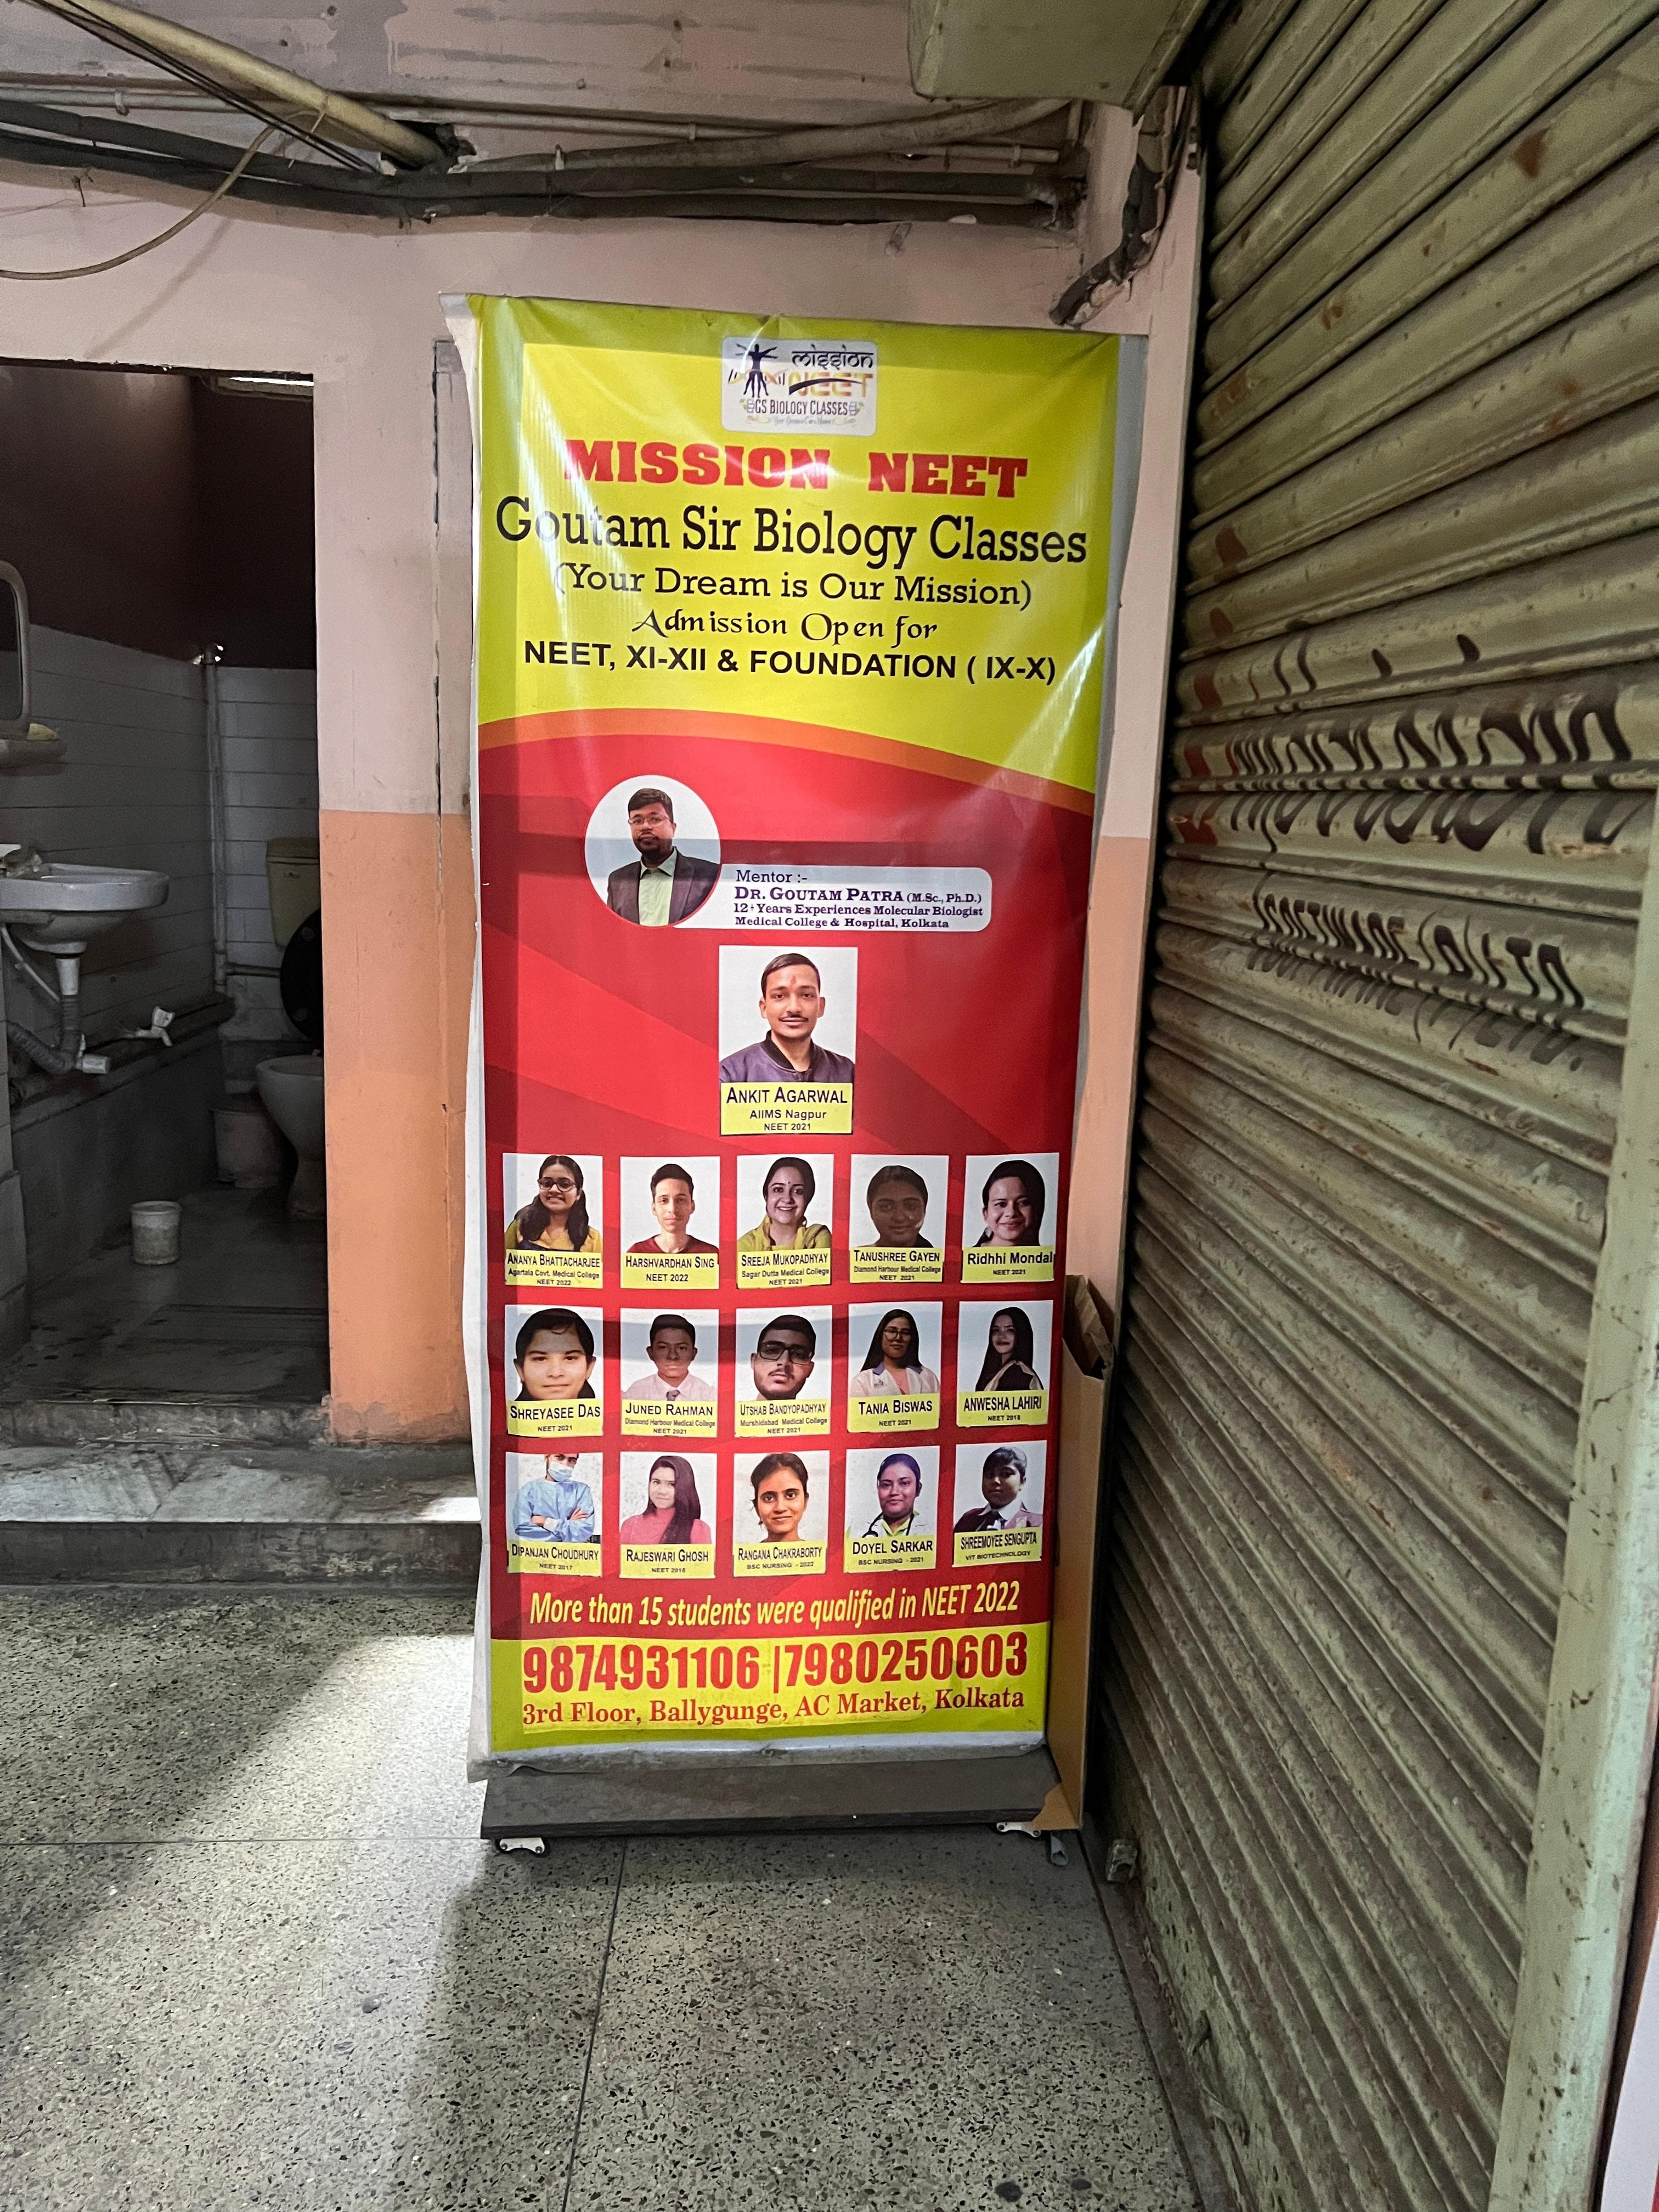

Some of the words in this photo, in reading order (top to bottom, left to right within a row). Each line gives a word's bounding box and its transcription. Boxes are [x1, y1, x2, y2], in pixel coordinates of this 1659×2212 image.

[792, 344, 873, 370] mission
[755, 399, 767, 414] GS
[770, 400, 808, 415] BIOLOGY
[810, 401, 848, 416] CLASSES
[565, 439, 830, 489] MISSION
[868, 453, 1028, 498] NEET
[496, 497, 670, 548] Goutam
[683, 505, 741, 550] Sir
[754, 507, 917, 569] Biology
[929, 514, 1087, 563] Classes
[556, 562, 645, 595] (Your
[654, 567, 771, 596] Dream
[780, 572, 806, 598] is
[819, 573, 881, 601] Our
[893, 576, 1032, 611] Mission)
[632, 608, 787, 638] Admission
[801, 612, 884, 646] Open
[891, 613, 938, 649] for
[524, 640, 615, 669] NEET,
[626, 645, 706, 671] XI-XII
[717, 649, 739, 673] &
[750, 650, 957, 679] FOUNDATION
[986, 657, 1056, 684] IX-X)
[736, 870, 792, 883] Mentor
[798, 873, 808, 883] :-
[734, 887, 766, 900] DR.
[770, 887, 842, 901] GOUTAM
[847, 888, 904, 902] PATRA
[946, 893, 982, 904] Ph.D.)
[794, 905, 871, 917] Experiences
[874, 906, 930, 916] Molecular
[932, 906, 983, 918] Biologist
[735, 917, 782, 926] Medical
[785, 917, 827, 928] College
[830, 919, 839, 927] &
[845, 918, 899, 929] Hospital,
[901, 918, 949, 928] Kolkata
[726, 1087, 770, 1103] ANKIT
[774, 1086, 848, 1103] AGARWAL
[786, 1110, 827, 1121] Nagpur
[507, 1252, 537, 1265] ANANYA
[540, 1254, 600, 1268] BHATTACHARJEE
[625, 1256, 692, 1268] HARSHVARDHAN
[695, 1256, 715, 1268] SING
[741, 1254, 770, 1267] SREEJA
[772, 1252, 828, 1266] MUKOPADHYAY
[854, 1250, 905, 1262] TANUSHREE
[909, 1250, 940, 1262] GAYEN
[968, 1252, 1006, 1265] Ridhhi
[1010, 1251, 1053, 1264] Mondal
[577, 1271, 600, 1279] College
[646, 1273, 668, 1282] NEET
[670, 1273, 689, 1282] 2022
[742, 1271, 760, 1279] Sagar
[510, 1405, 574, 1420] SHREYASEE
[578, 1403, 601, 1418] DAS
[625, 1402, 662, 1415] JUNED
[666, 1403, 713, 1416] RAHMAN
[741, 1403, 767, 1416] UTSHAB
[769, 1402, 826, 1415] BANDYOPADHYAY
[859, 1401, 889, 1415] TANIA
[893, 1400, 933, 1414] BISWAS
[963, 1396, 1010, 1412] ANWESHA
[1012, 1396, 1042, 1410] LAHIRI
[740, 1418, 778, 1426] Murshidabad
[806, 1417, 827, 1425] College
[853, 1541, 887, 1555] DOYEL
[890, 1539, 933, 1553] SARKAR
[961, 1534, 1003, 1550] SHREEMOYEE
[1005, 1532, 1037, 1546] SENGUPTA
[512, 1543, 549, 1559] DIPANJAN
[551, 1546, 599, 1561] CHOUDHURY
[627, 1549, 675, 1562] RAJESWARI
[679, 1549, 709, 1562] GHOSH
[738, 1548, 771, 1561] RANGANA
[773, 1545, 822, 1560] CHAKRABORTY
[977, 1550, 1031, 1560] BIOTECHNOLOGY
[529, 1591, 584, 1624] More
[588, 1593, 634, 1625] than
[639, 1595, 662, 1626] 15
[668, 1595, 751, 1626] students
[757, 1599, 803, 1625] were
[808, 1591, 895, 1629] qualified
[899, 1589, 918, 1618] in
[921, 1584, 967, 1617] NEET
[974, 1581, 1020, 1613] 2022
[523, 1644, 760, 1694] 9874931106
[523, 1703, 563, 1726] 3rd
[570, 1702, 642, 1725] Floor,
[650, 1700, 788, 1727] Ballygunge,
[794, 1695, 830, 1716] AC
[836, 1690, 927, 1716] Market,
[934, 1686, 1025, 1709] Kolkata
